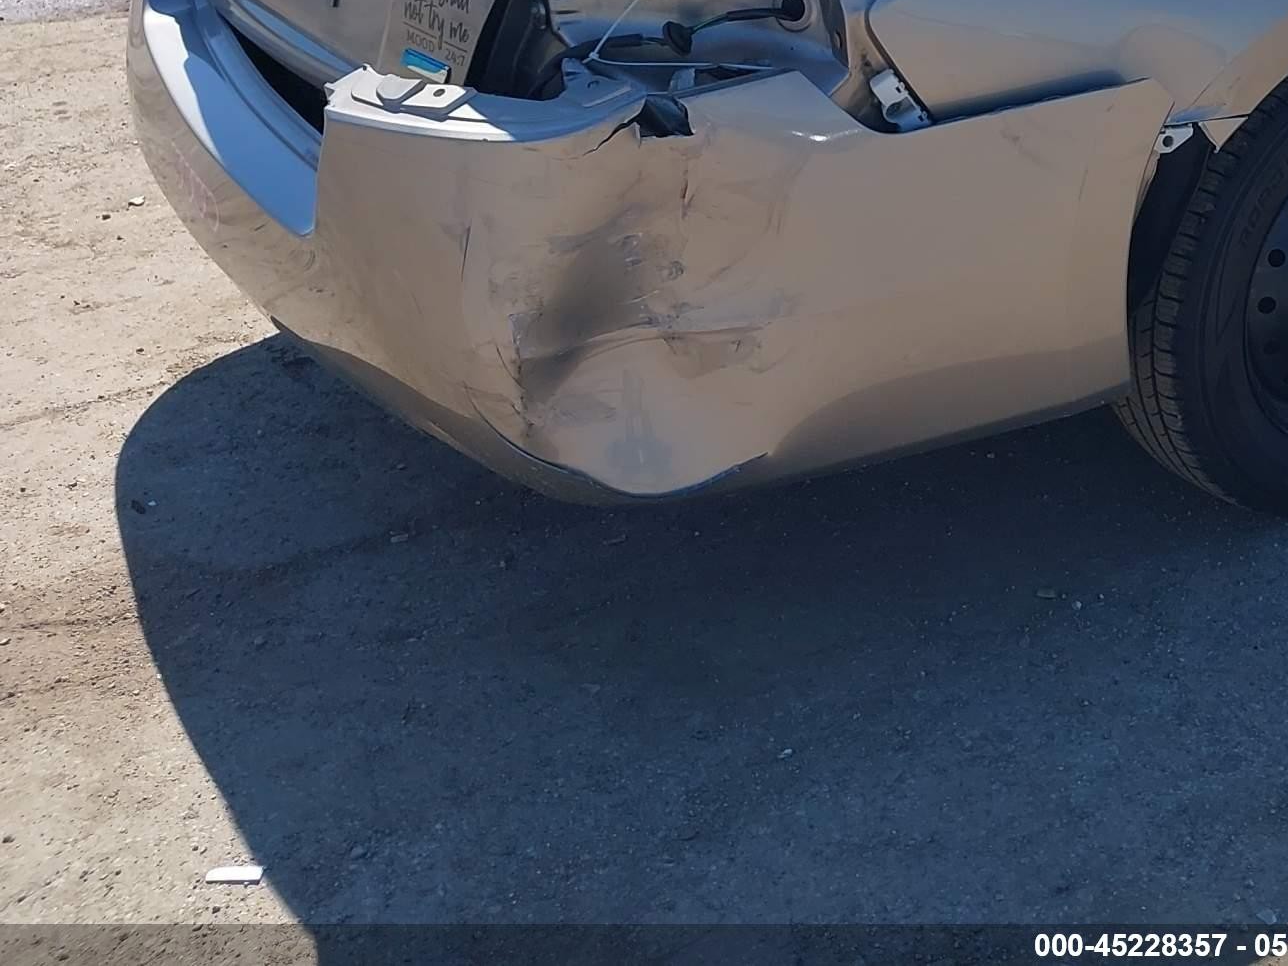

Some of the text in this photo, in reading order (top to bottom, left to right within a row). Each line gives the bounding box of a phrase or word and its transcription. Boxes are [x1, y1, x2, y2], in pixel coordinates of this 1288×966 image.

[406, 29, 435, 53] MOOD
[425, 3, 445, 50] try
[449, 20, 470, 43] me
